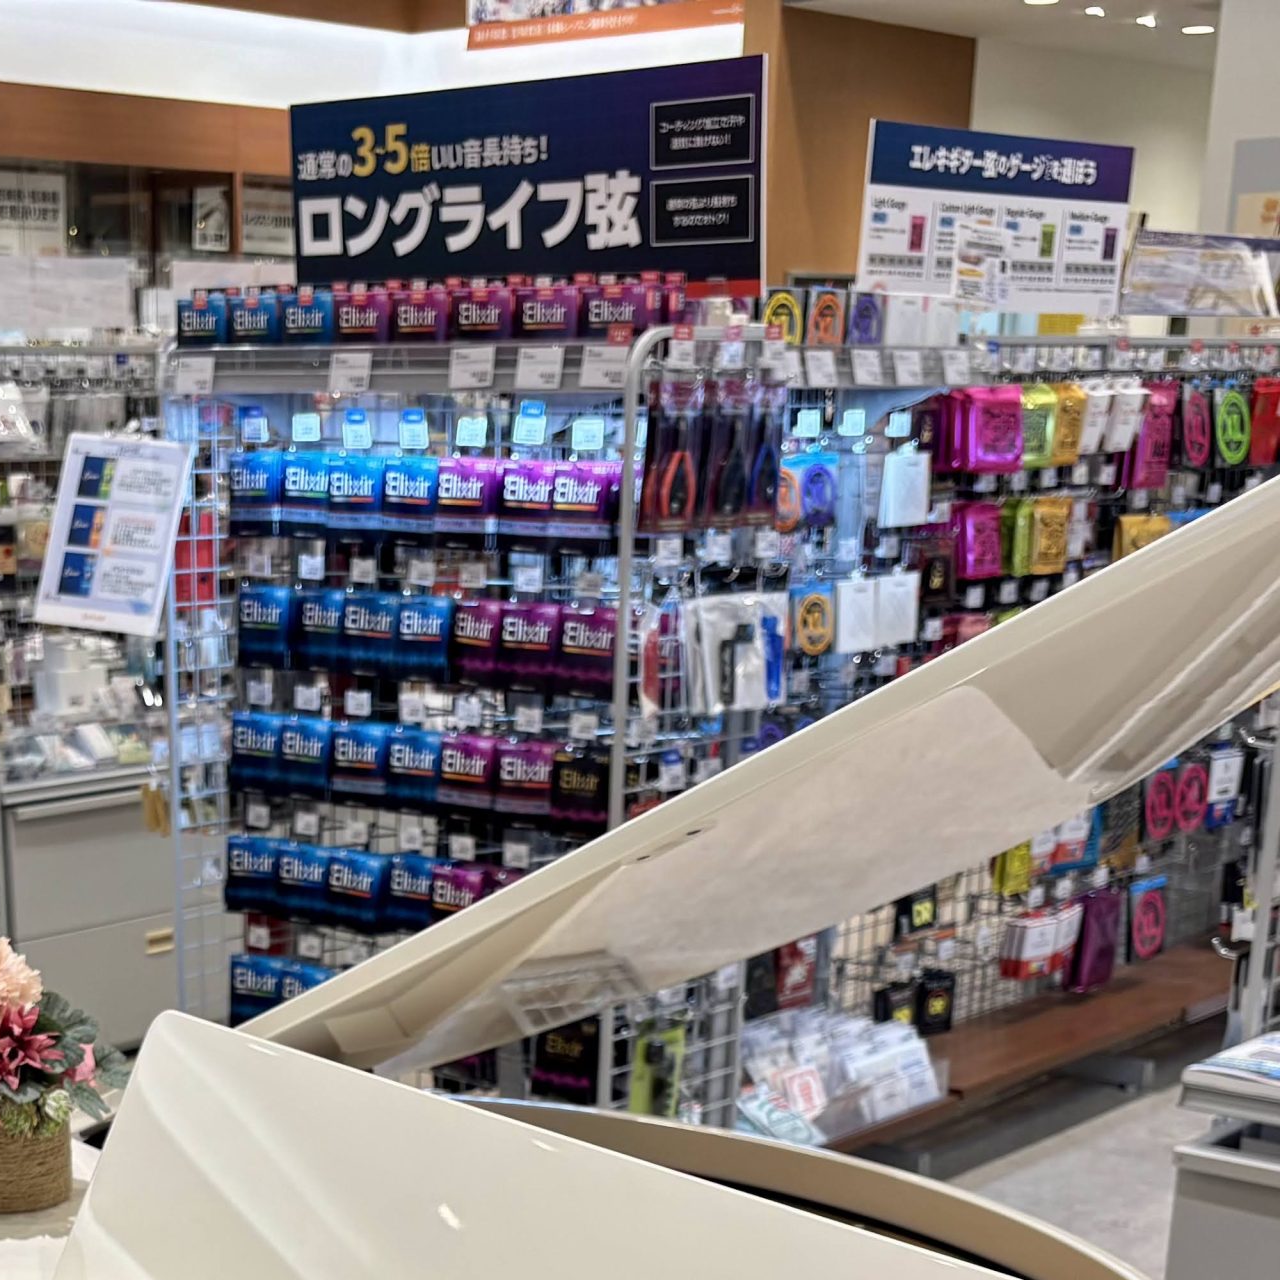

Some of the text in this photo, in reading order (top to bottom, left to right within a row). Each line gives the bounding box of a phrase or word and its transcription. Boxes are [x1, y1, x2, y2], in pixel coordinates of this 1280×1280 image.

[298, 169, 643, 258] ロングライフ弦
[181, 309, 219, 331] Elixir
[233, 309, 270, 331] Elixir
[285, 306, 325, 329] Elixir
[339, 306, 380, 329] Elixir
[398, 305, 438, 327] Elixir
[458, 302, 502, 325] Elixir
[522, 301, 568, 324] Elixir
[588, 299, 637, 323] Elixir
[231, 467, 269, 490] Elixir
[330, 471, 375, 497] Elixir
[385, 471, 431, 498] Elixir
[438, 472, 484, 500] Elixir
[503, 473, 553, 503] Elixir
[553, 476, 601, 504] Elixir
[240, 599, 282, 624] Elixir
[302, 601, 341, 627] Elixir
[344, 604, 393, 632] Elixir
[399, 609, 444, 635] Elixir
[454, 611, 494, 640] Elixir
[502, 615, 552, 645] Elixir
[562, 619, 616, 650] Elixir
[234, 725, 277, 752] Elixir
[282, 730, 323, 757] Elixir
[334, 736, 378, 764] Elixir
[389, 742, 437, 770] Elixir
[441, 749, 488, 777] Elixir
[499, 755, 553, 783] Elixir
[560, 769, 600, 793] Elixir
[229, 849, 275, 873] Elixir
[278, 855, 324, 883] Elixir
[329, 862, 374, 891] Elixir
[390, 867, 433, 894] Elixir
[233, 967, 278, 993] Elixir
